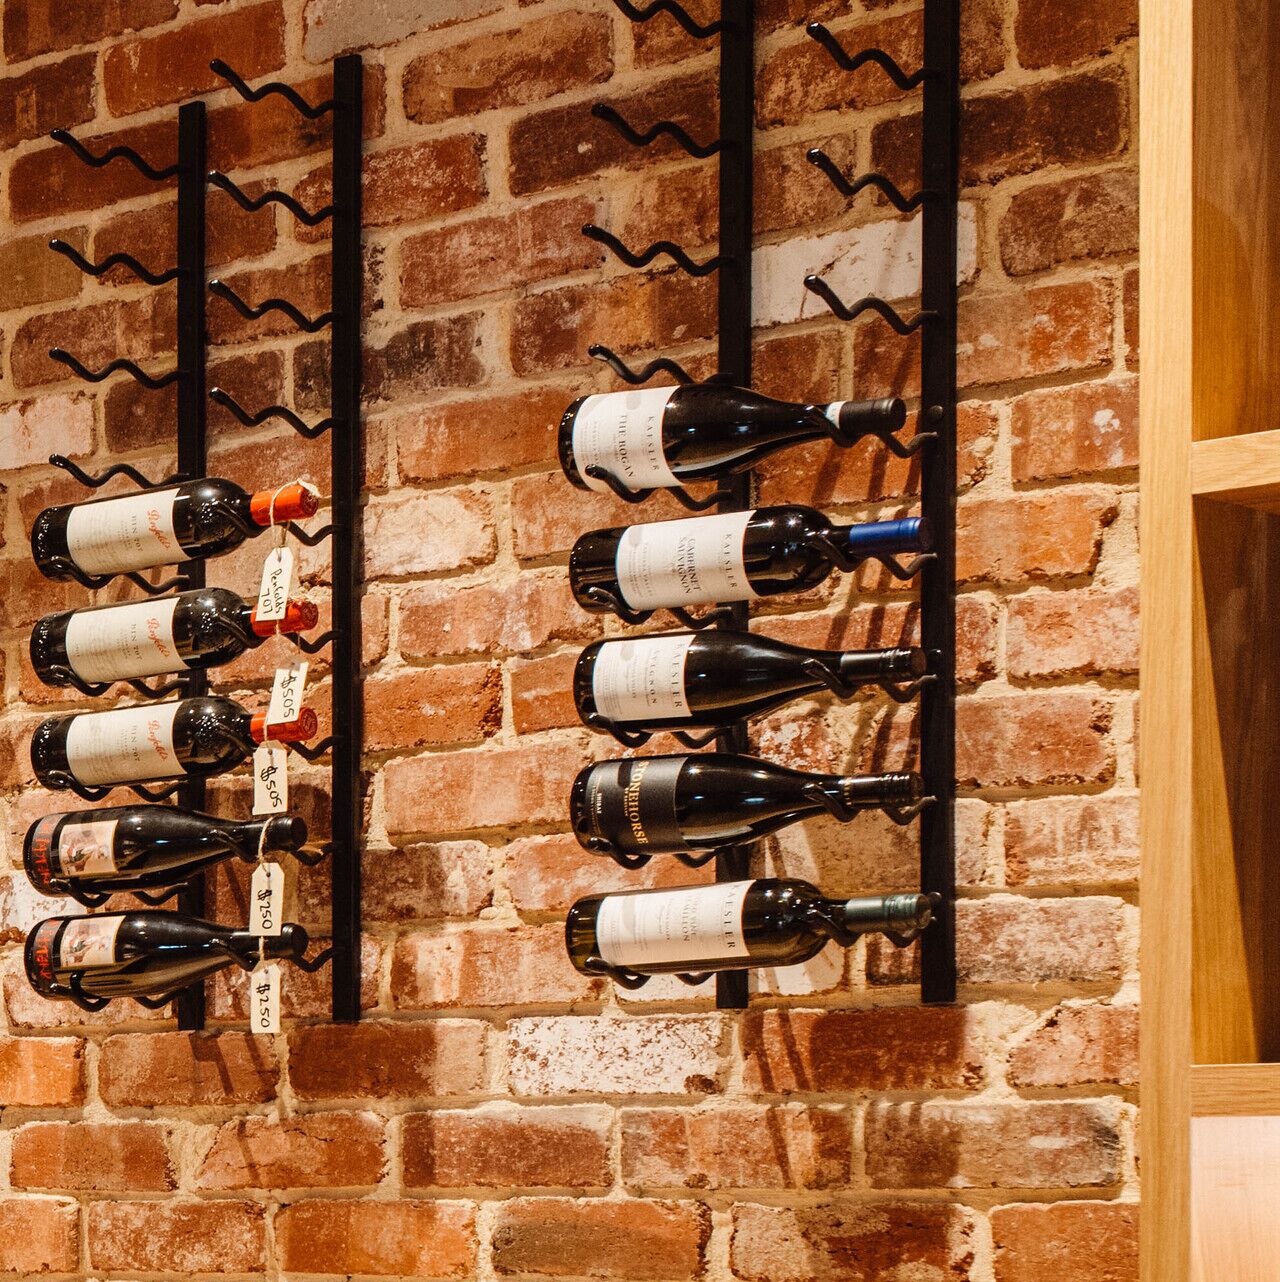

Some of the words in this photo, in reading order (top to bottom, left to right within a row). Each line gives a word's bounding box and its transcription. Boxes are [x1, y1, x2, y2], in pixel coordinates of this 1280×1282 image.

[618, 441, 635, 479] BOGAN
[260, 588, 273, 614] 707
[280, 675, 297, 718] $505
[260, 766, 283, 807] $505
[257, 889, 273, 930] $250
[256, 983, 271, 1028] $250
